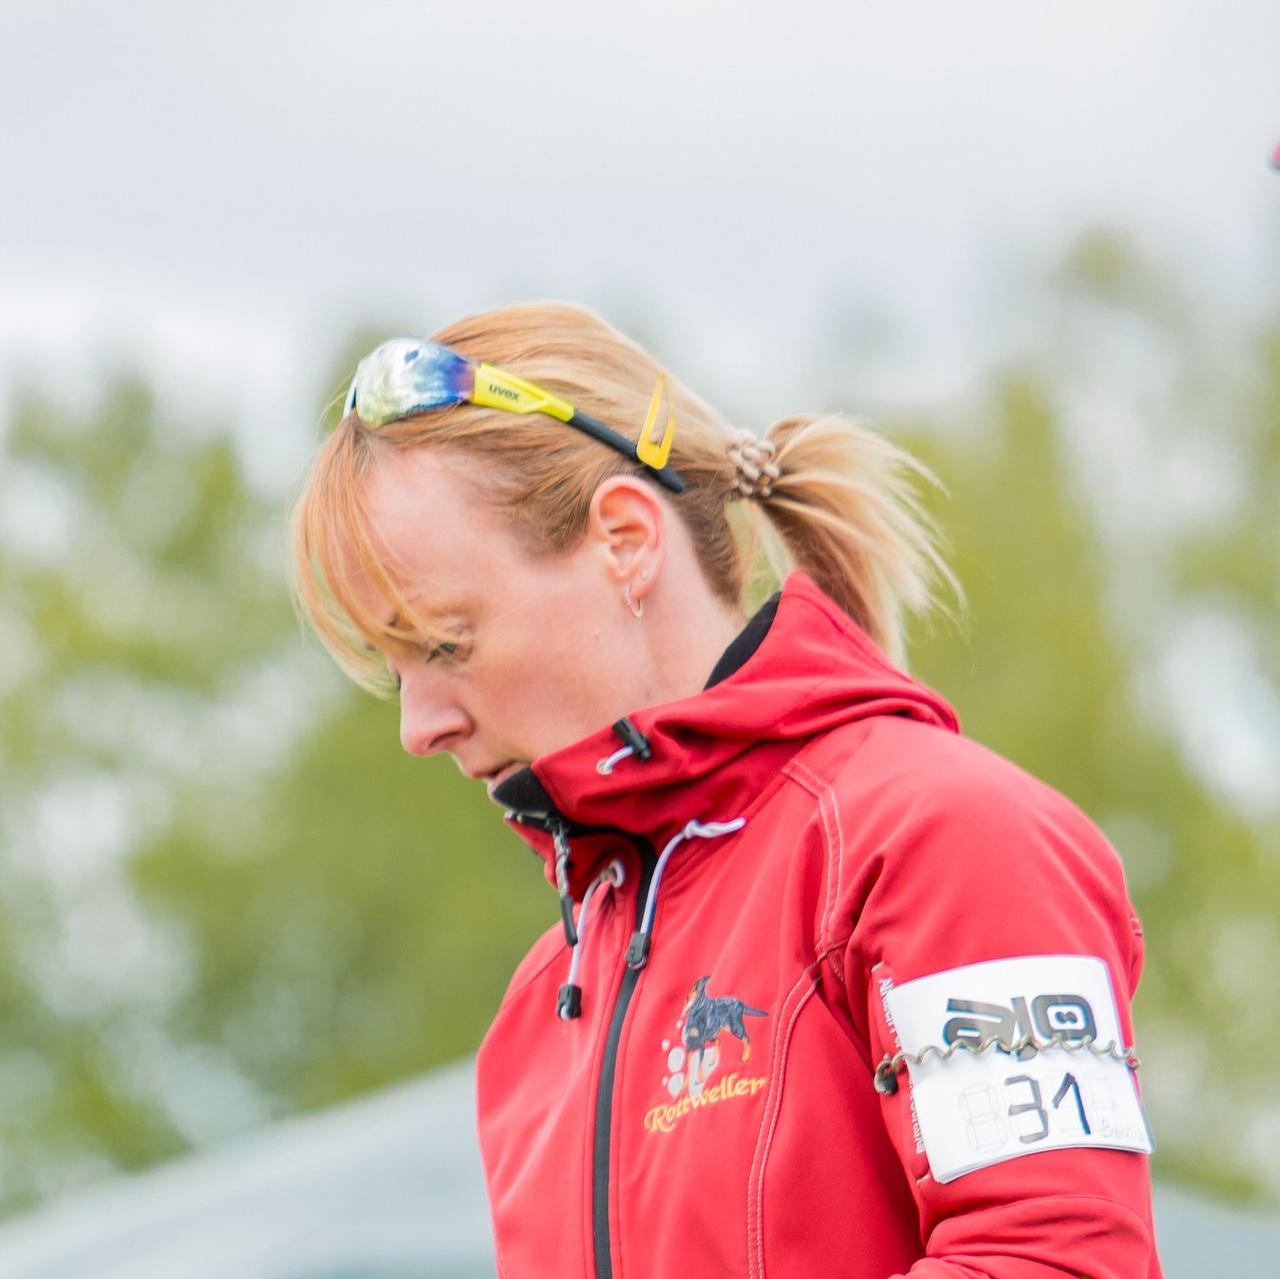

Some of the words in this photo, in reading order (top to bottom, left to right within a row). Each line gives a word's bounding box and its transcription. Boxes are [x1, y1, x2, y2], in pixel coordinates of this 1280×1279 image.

[488, 384, 519, 401] uvex
[644, 1072, 766, 1133] Rottweiler
[1003, 1072, 1092, 1144] 31
